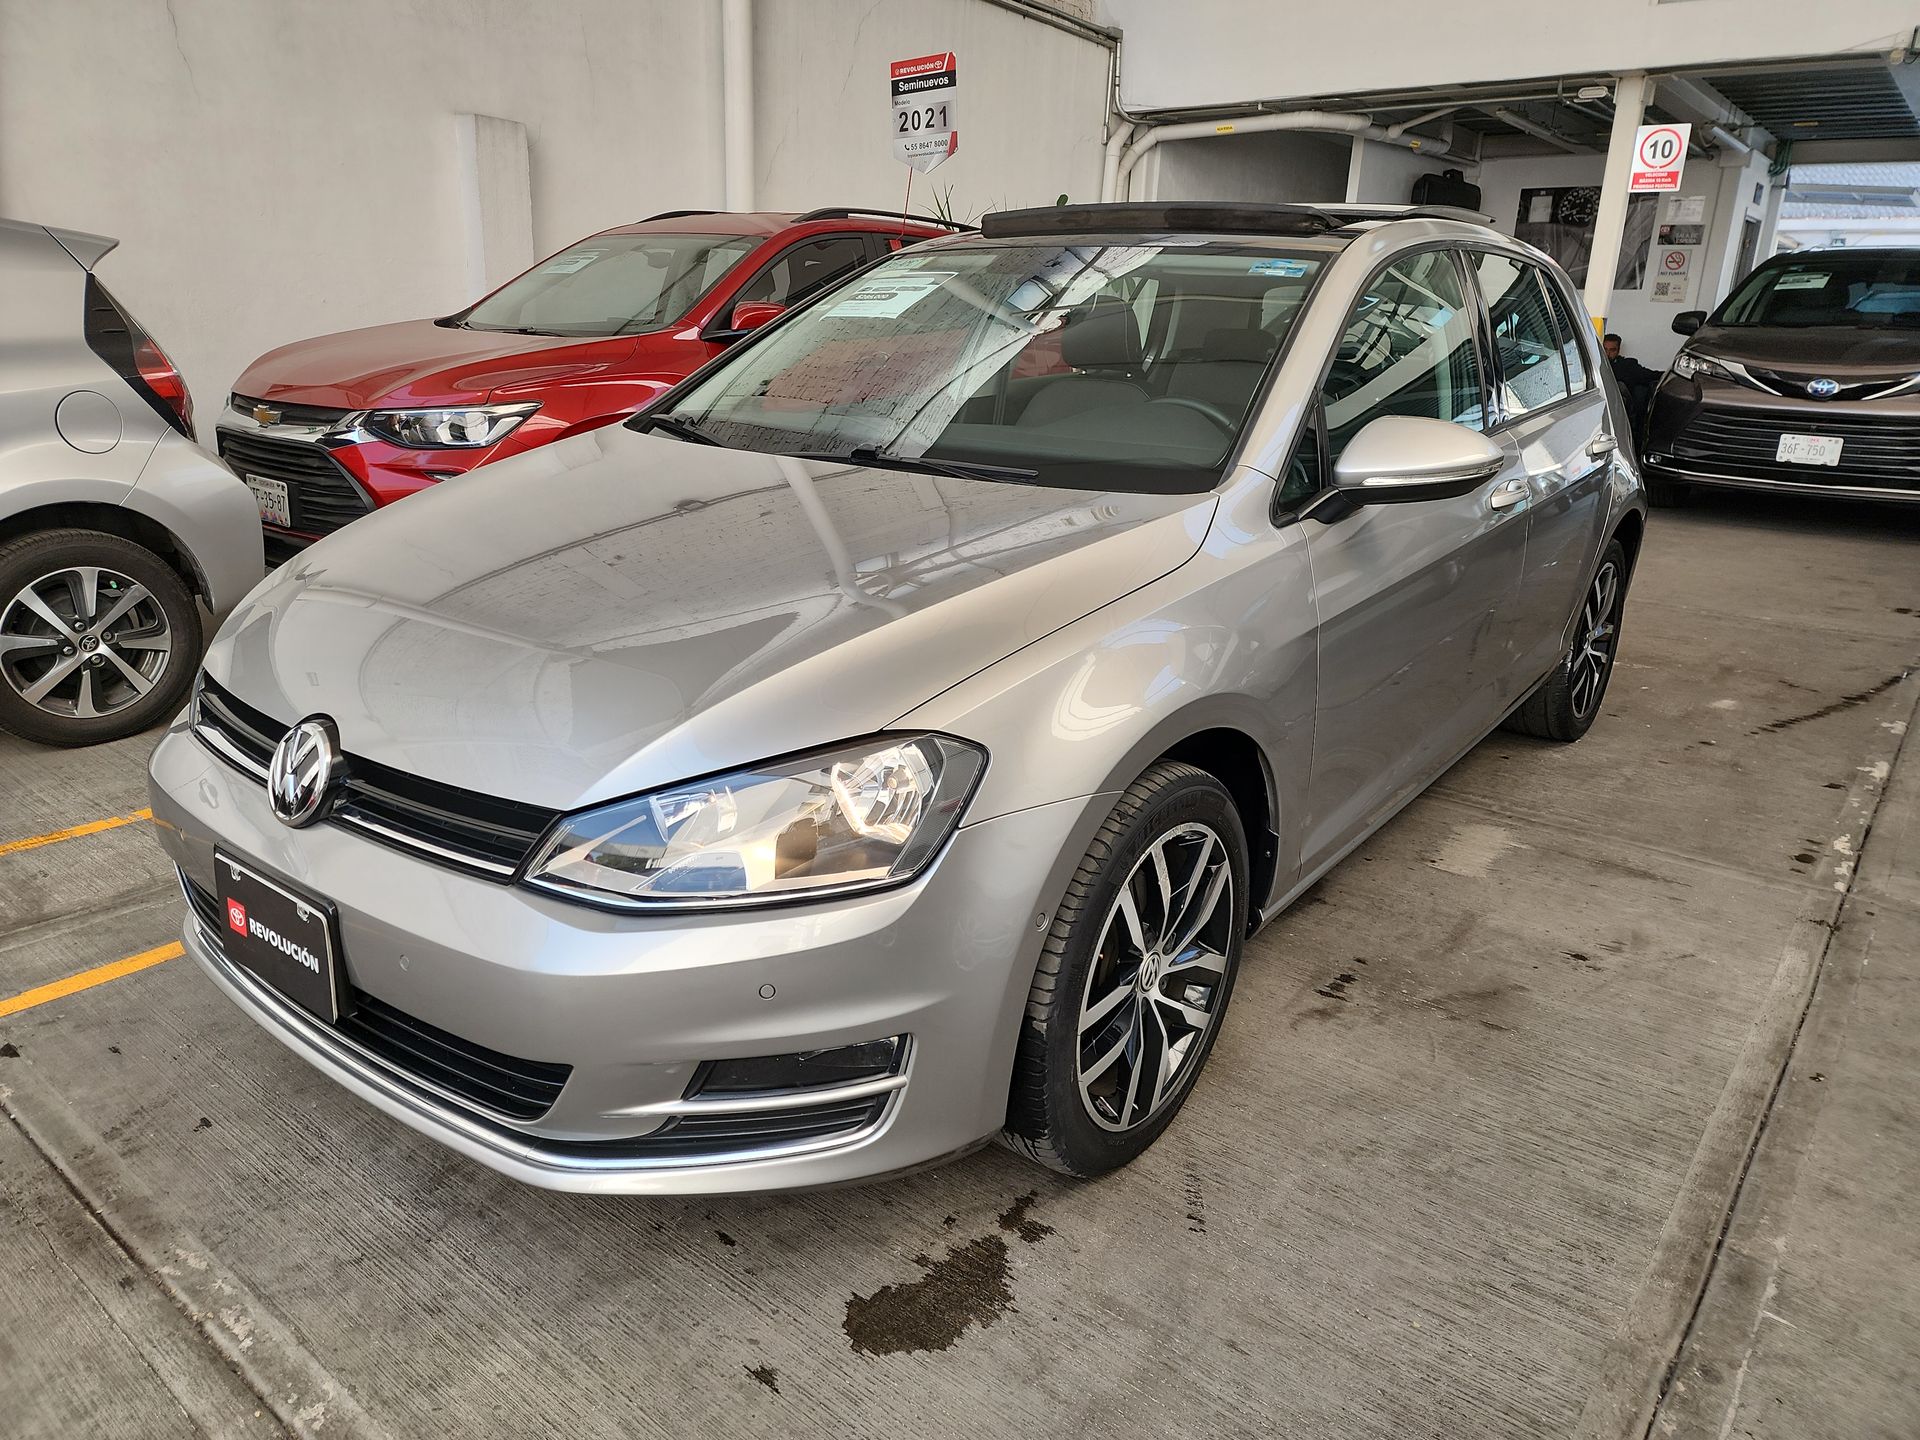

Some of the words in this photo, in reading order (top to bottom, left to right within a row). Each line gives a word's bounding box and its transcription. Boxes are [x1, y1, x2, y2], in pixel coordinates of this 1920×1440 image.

[899, 62, 935, 74] REVOLUCIÓN
[898, 76, 949, 92] Seminuevos
[899, 105, 948, 132] 2021
[910, 143, 918, 151] 55
[918, 141, 933, 149] 8647
[934, 139, 948, 148] 8000
[1649, 139, 1674, 159] 10
[248, 917, 320, 975] REVOLUCIÓN
